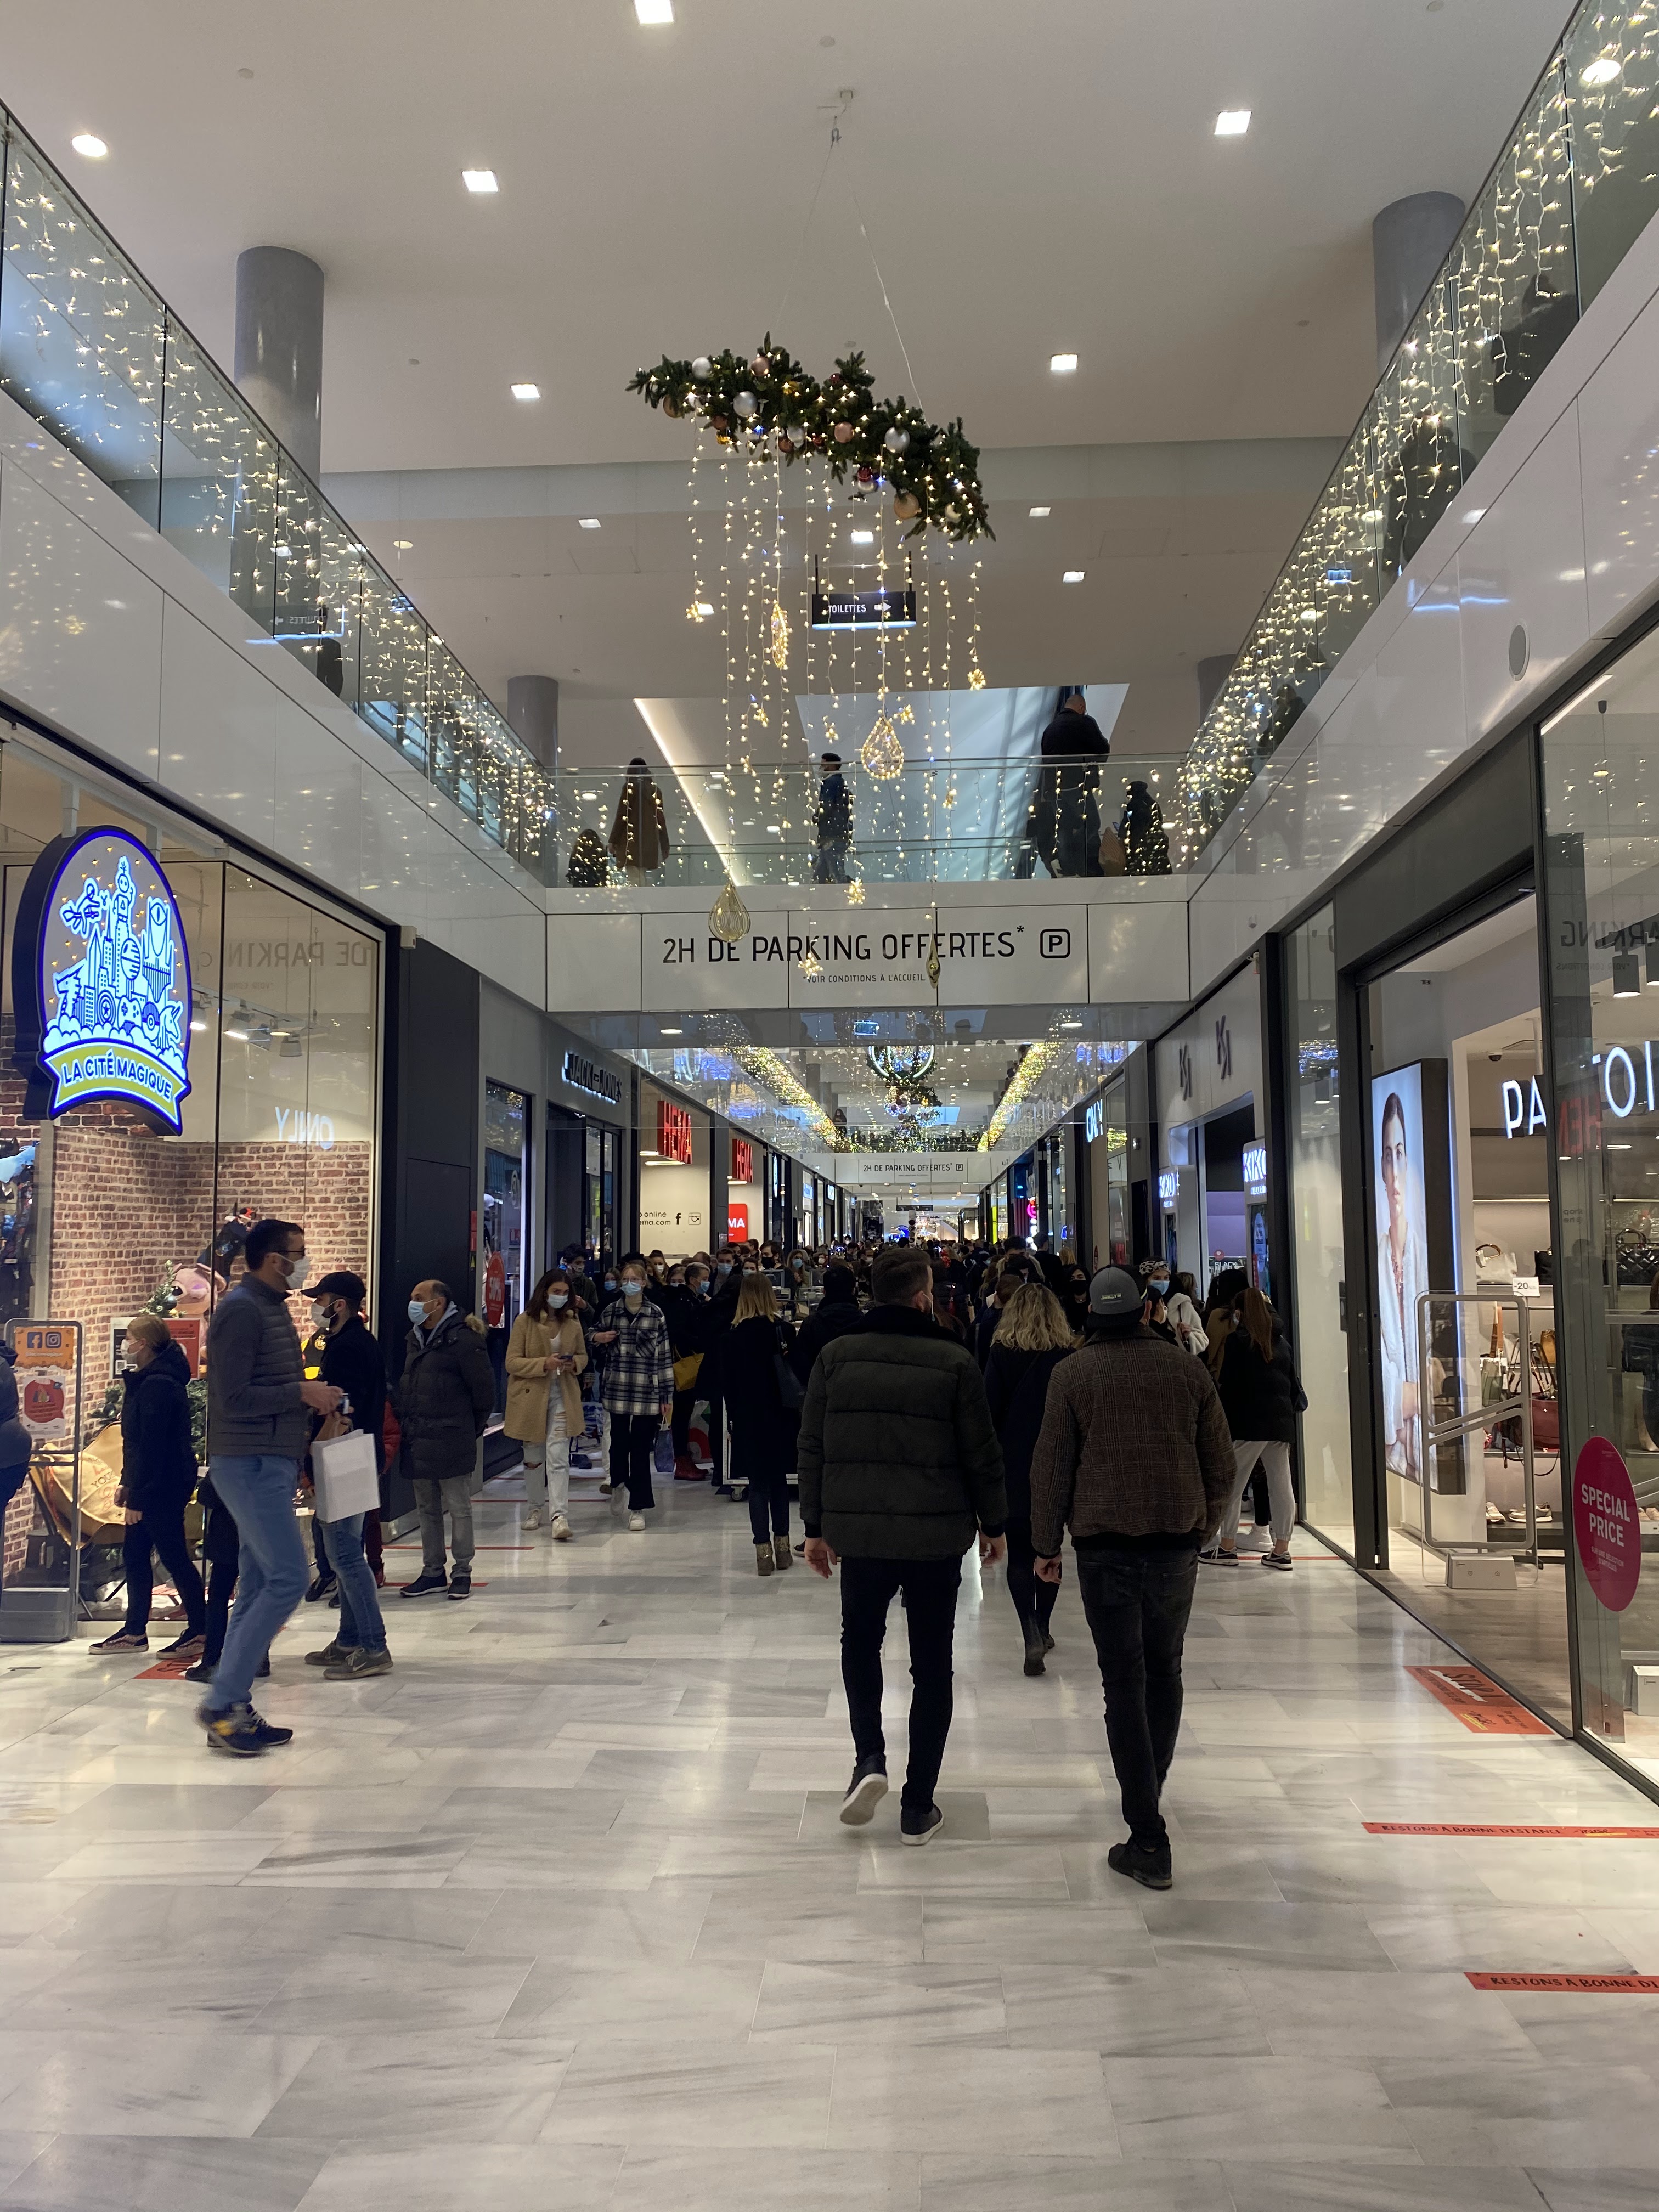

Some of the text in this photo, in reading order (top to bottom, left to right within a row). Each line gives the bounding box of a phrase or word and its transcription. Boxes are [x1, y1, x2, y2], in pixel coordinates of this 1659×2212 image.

[828, 604, 866, 613] TOILETTES
[663, 938, 695, 963] 2H
[708, 936, 740, 962] DE
[752, 934, 871, 962] PARKING
[880, 973, 885, 981] À
[62, 1048, 173, 1102] LA CITÉ MAGIQUE
[564, 1052, 593, 1092] JACK
[599, 1069, 622, 1103] JONES
[658, 1100, 692, 1164] HEMA
[1086, 1099, 1103, 1143] ONLY
[732, 1139, 753, 1183] HEMA
[1159, 1173, 1175, 1198] KIKO
[1582, 1483, 1630, 1522] SPECIAL
[1589, 1513, 1624, 1547] PRICE
[1490, 1977, 1562, 1987] RESTONS
[1579, 1978, 1637, 1988] BONNE
